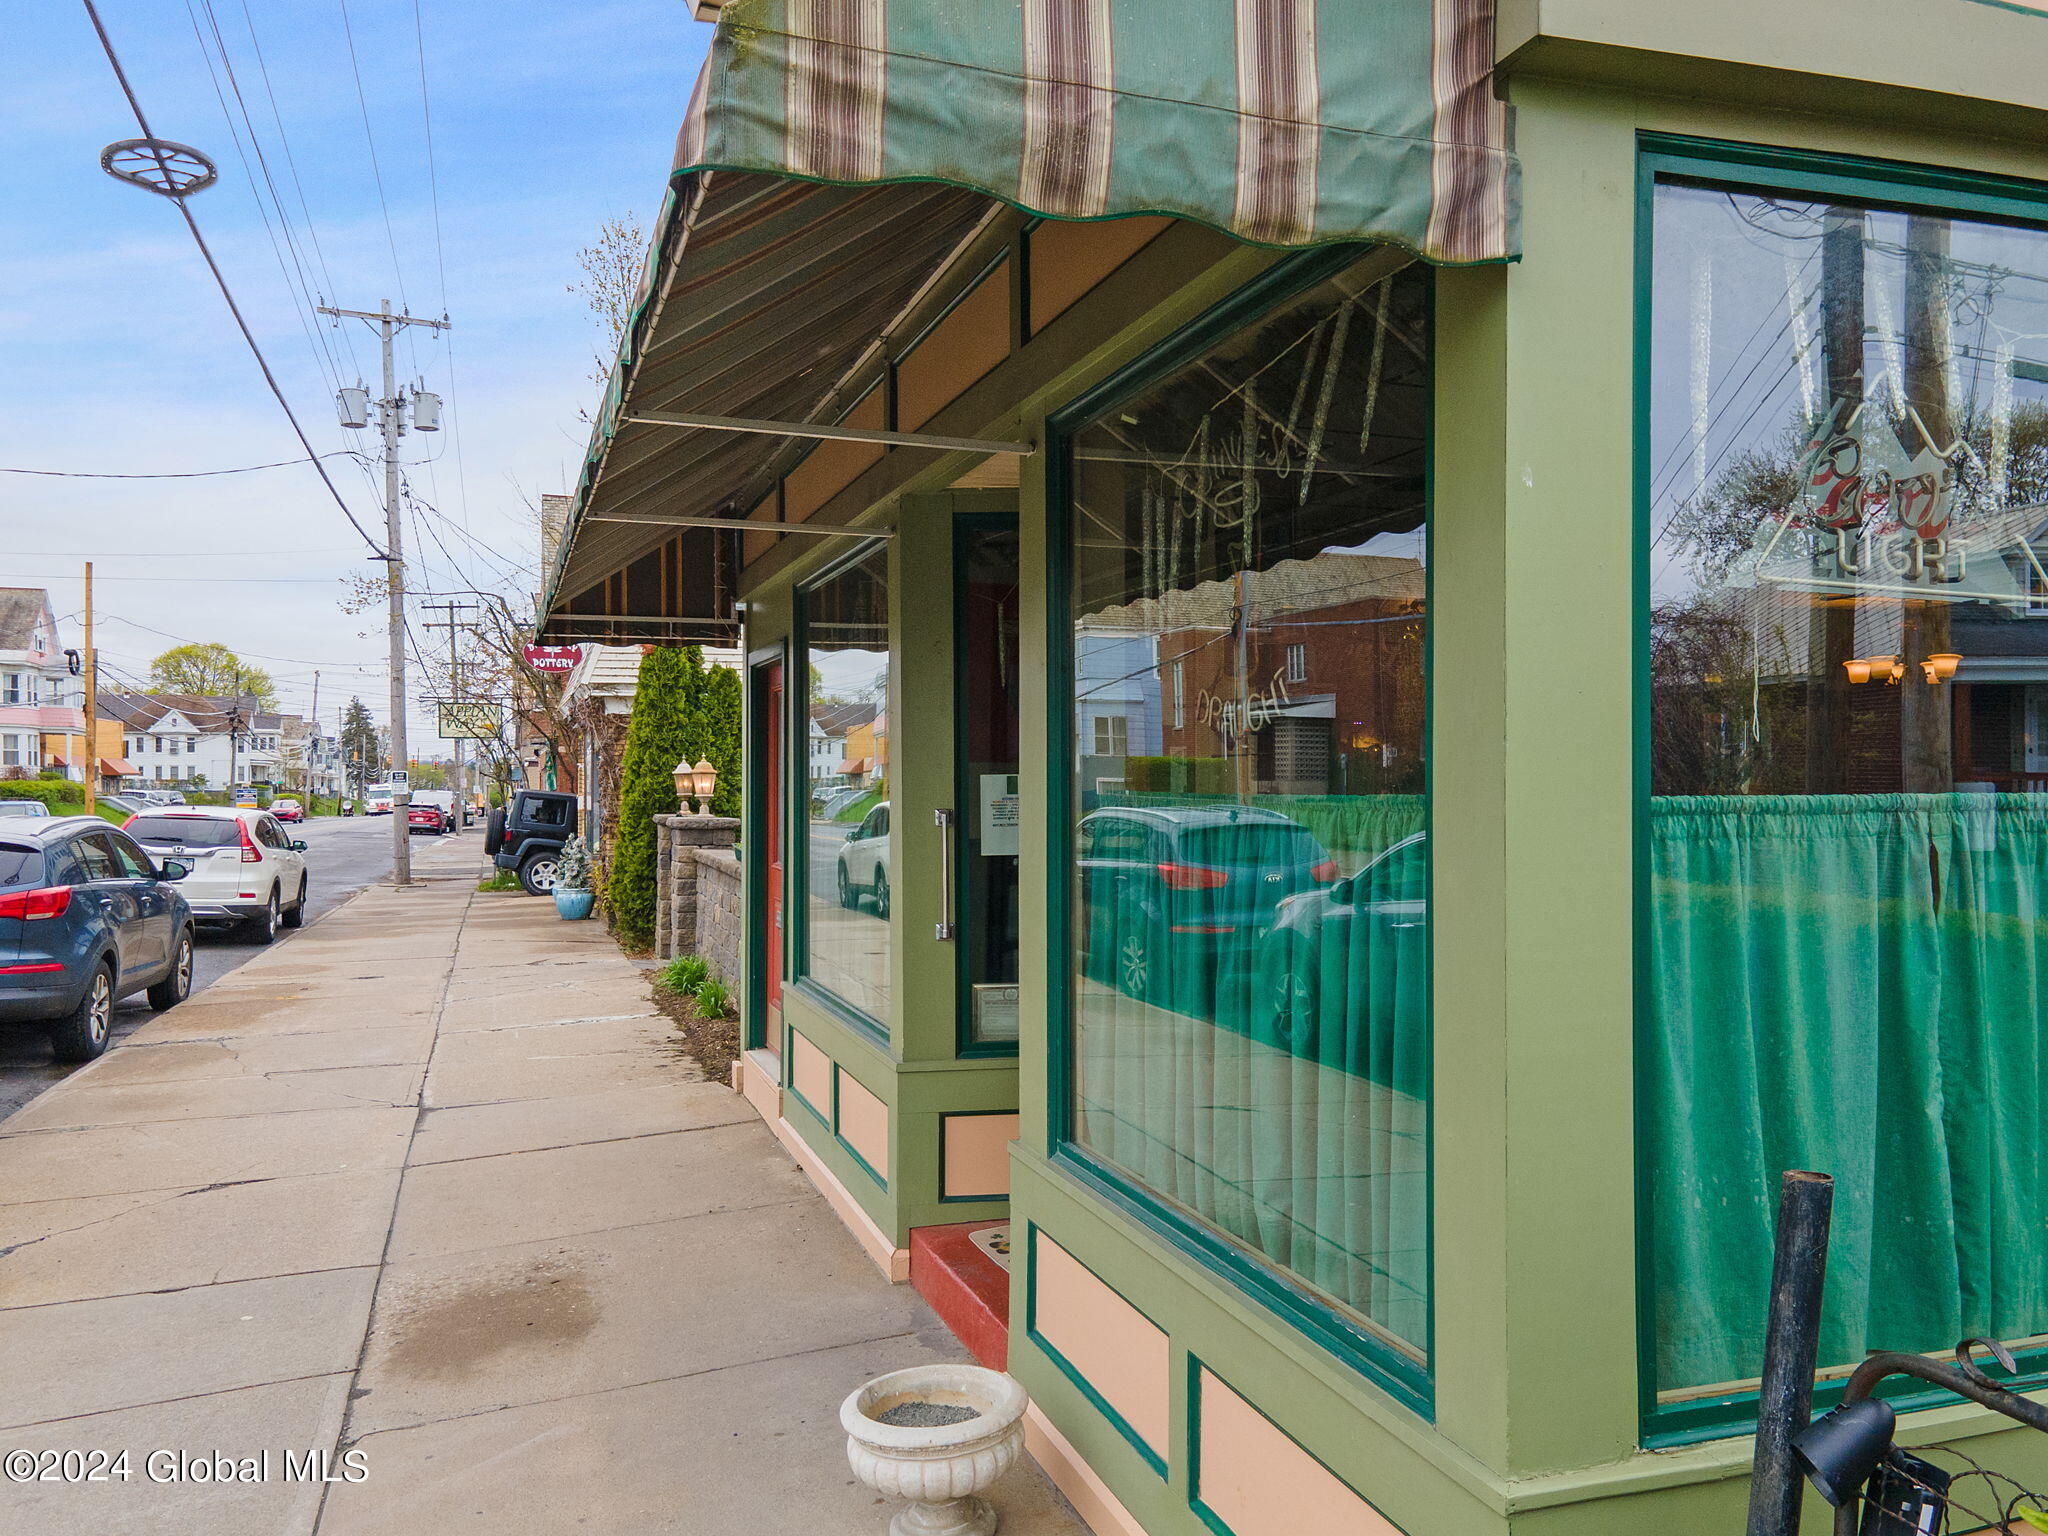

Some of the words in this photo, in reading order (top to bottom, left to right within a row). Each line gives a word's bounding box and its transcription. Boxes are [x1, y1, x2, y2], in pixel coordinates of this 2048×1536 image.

[1836, 529, 1971, 584] LIGHT
[532, 658, 574, 668] POTTERY
[445, 705, 498, 717] APPIAN
[1195, 666, 1291, 738] DRAGHT
